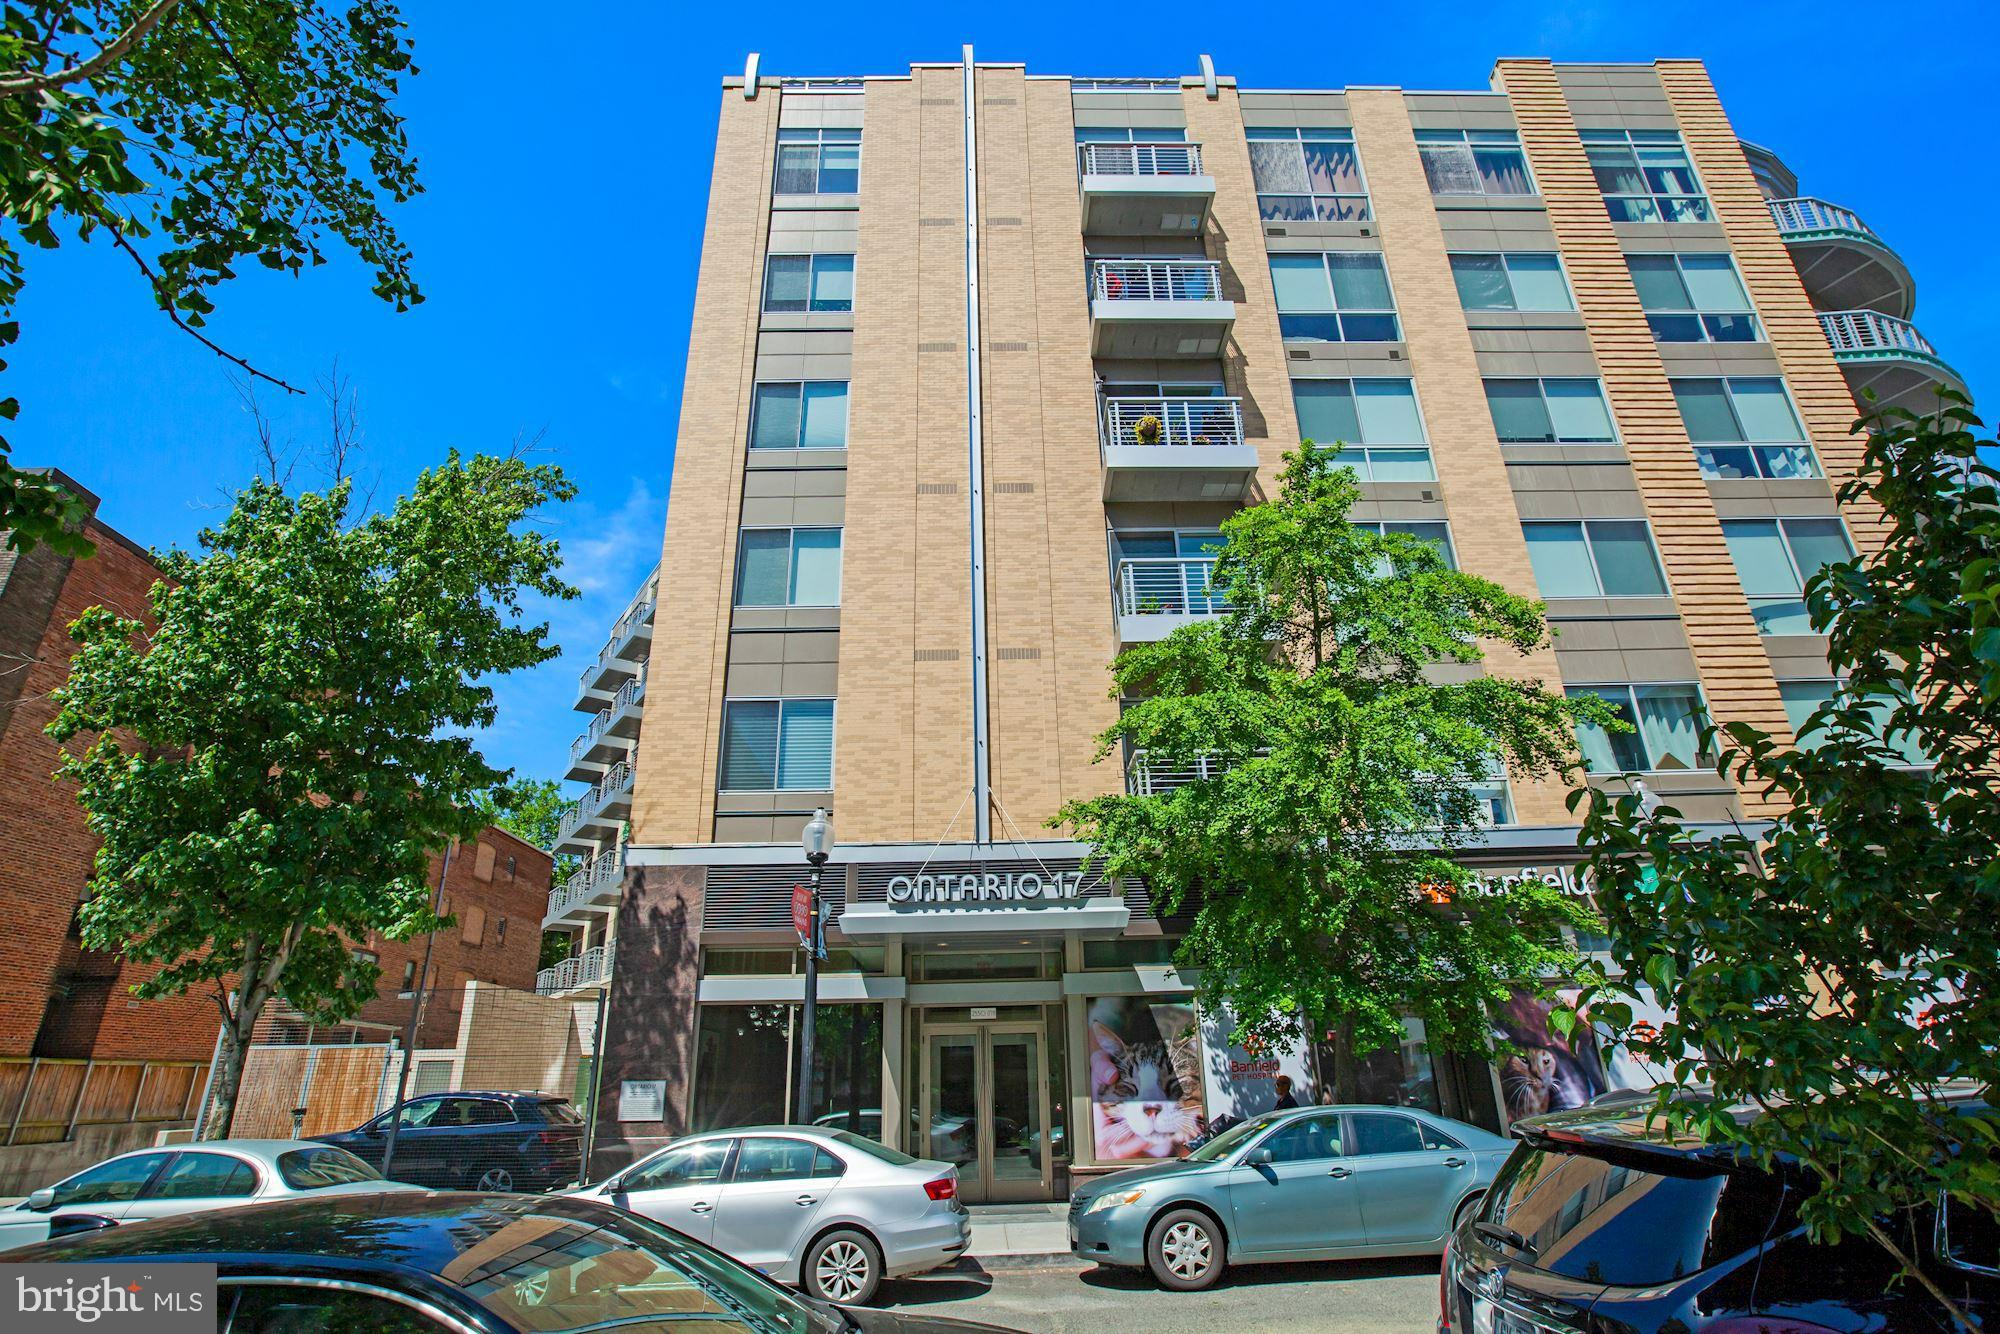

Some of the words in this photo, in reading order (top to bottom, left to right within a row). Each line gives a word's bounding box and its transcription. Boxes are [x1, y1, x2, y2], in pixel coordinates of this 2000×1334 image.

[887, 872, 1044, 902] ONTARIO
[1051, 871, 1085, 898] 17
[1231, 1060, 1280, 1072] Banfield
[1232, 1073, 1246, 1081] PET
